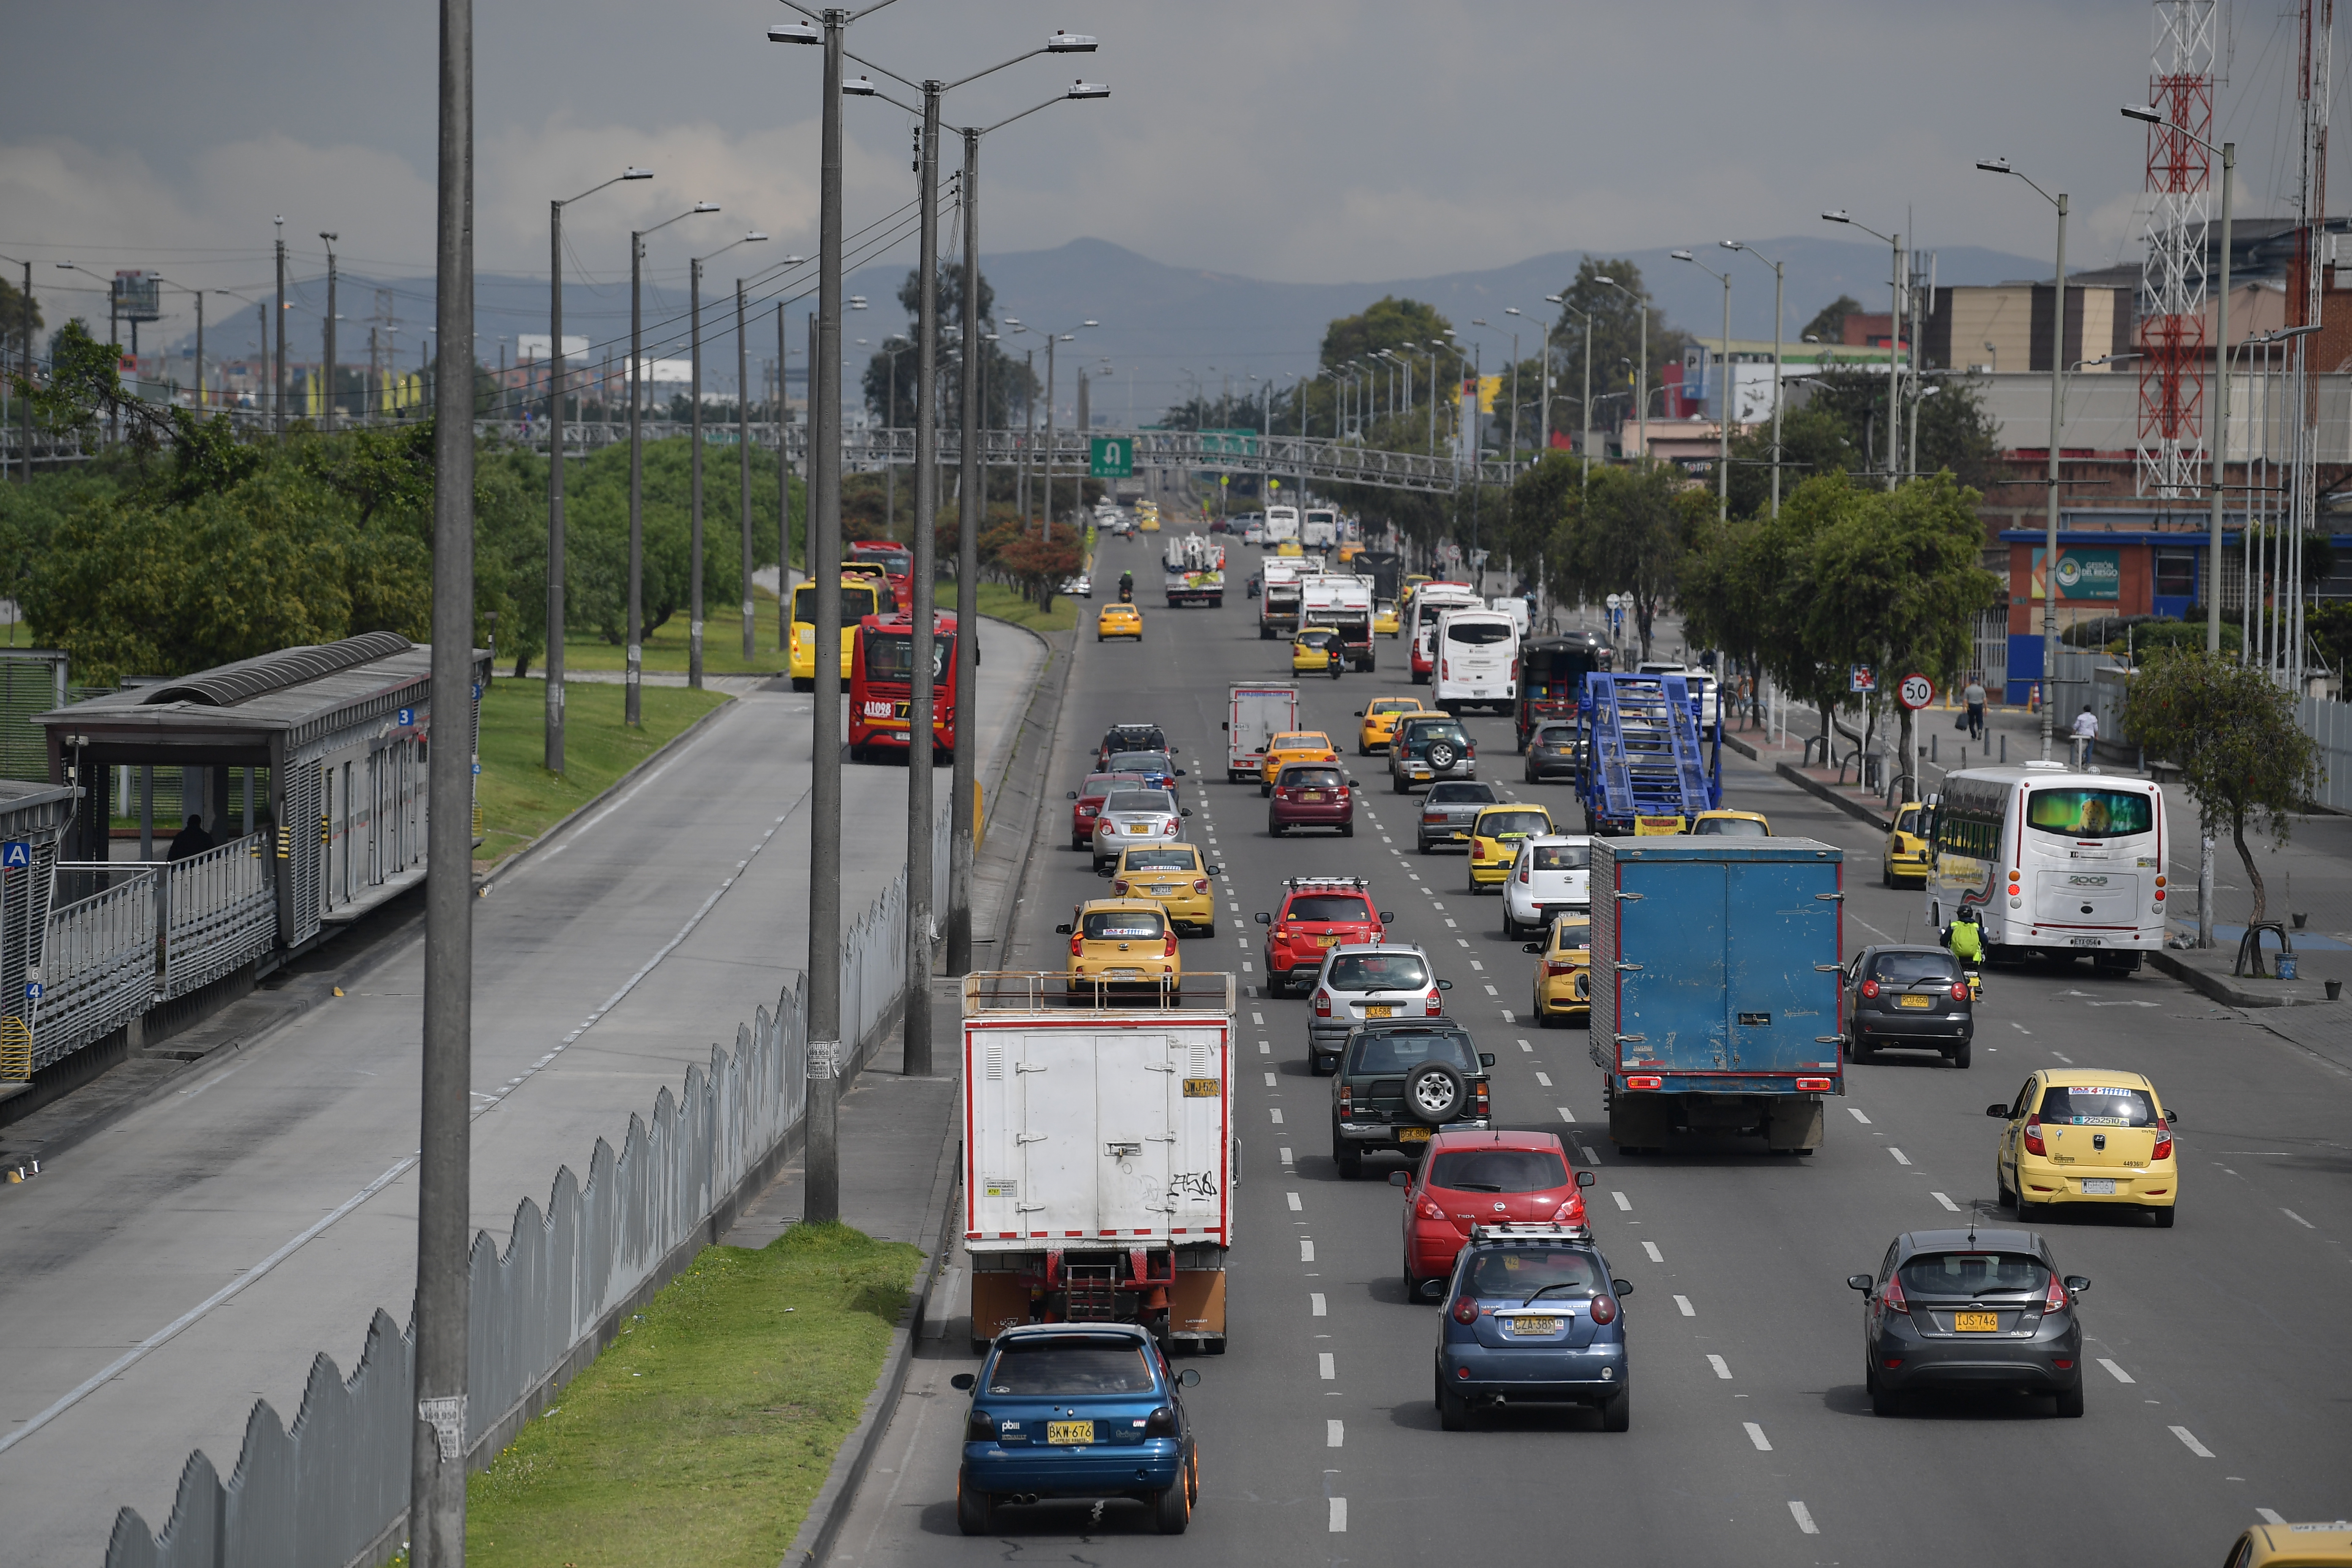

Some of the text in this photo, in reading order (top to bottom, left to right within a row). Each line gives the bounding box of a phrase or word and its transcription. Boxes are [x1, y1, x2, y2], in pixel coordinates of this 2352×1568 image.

[1906, 683, 1927, 699] 50
[400, 710, 408, 724] 3
[8, 845, 27, 864] A
[31, 968, 39, 980] 6
[30, 985, 40, 997] 4
